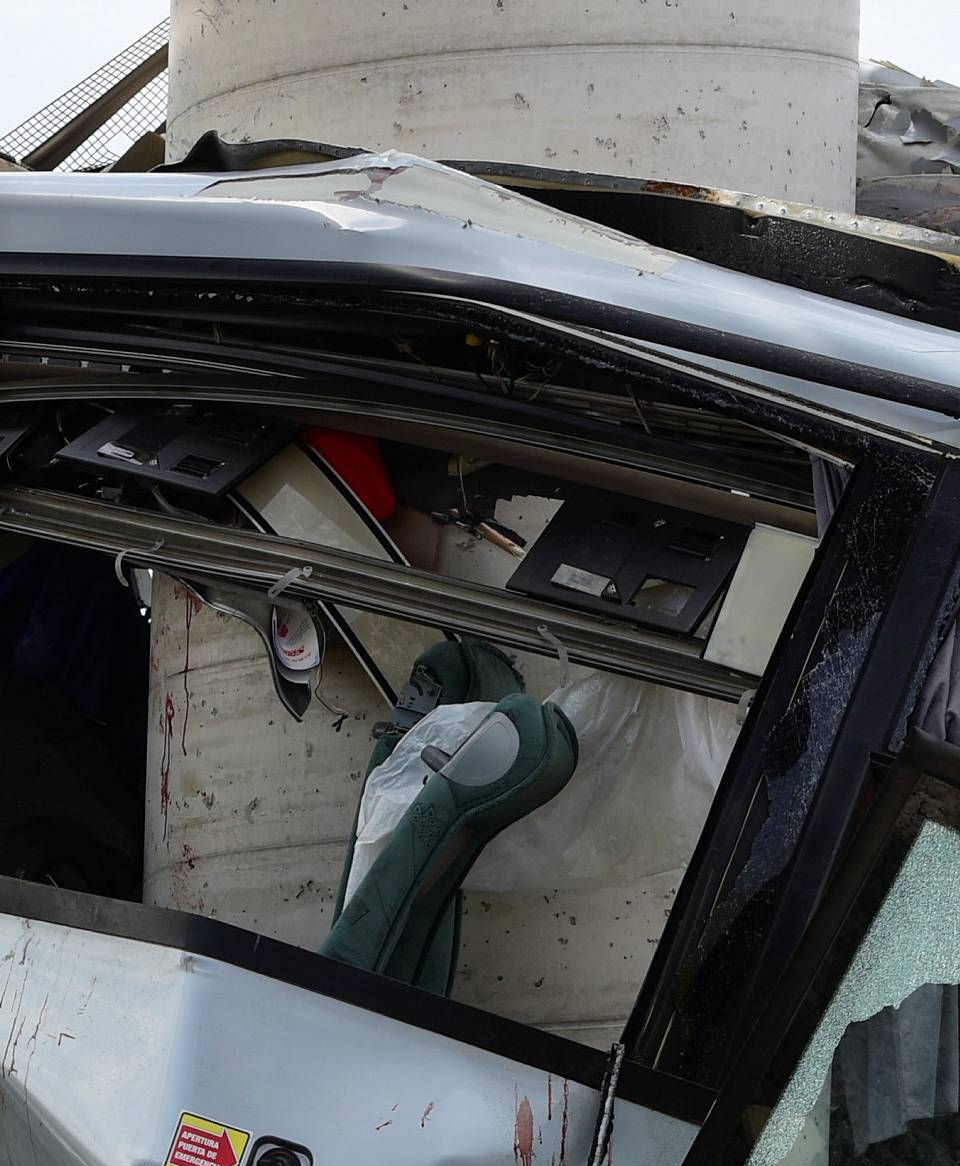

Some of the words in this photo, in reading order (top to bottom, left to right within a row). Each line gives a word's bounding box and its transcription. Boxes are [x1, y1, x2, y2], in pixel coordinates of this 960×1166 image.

[181, 1131, 219, 1149] APERTURA
[177, 1140, 206, 1156] PUERTA
[206, 1150, 218, 1160] DE
